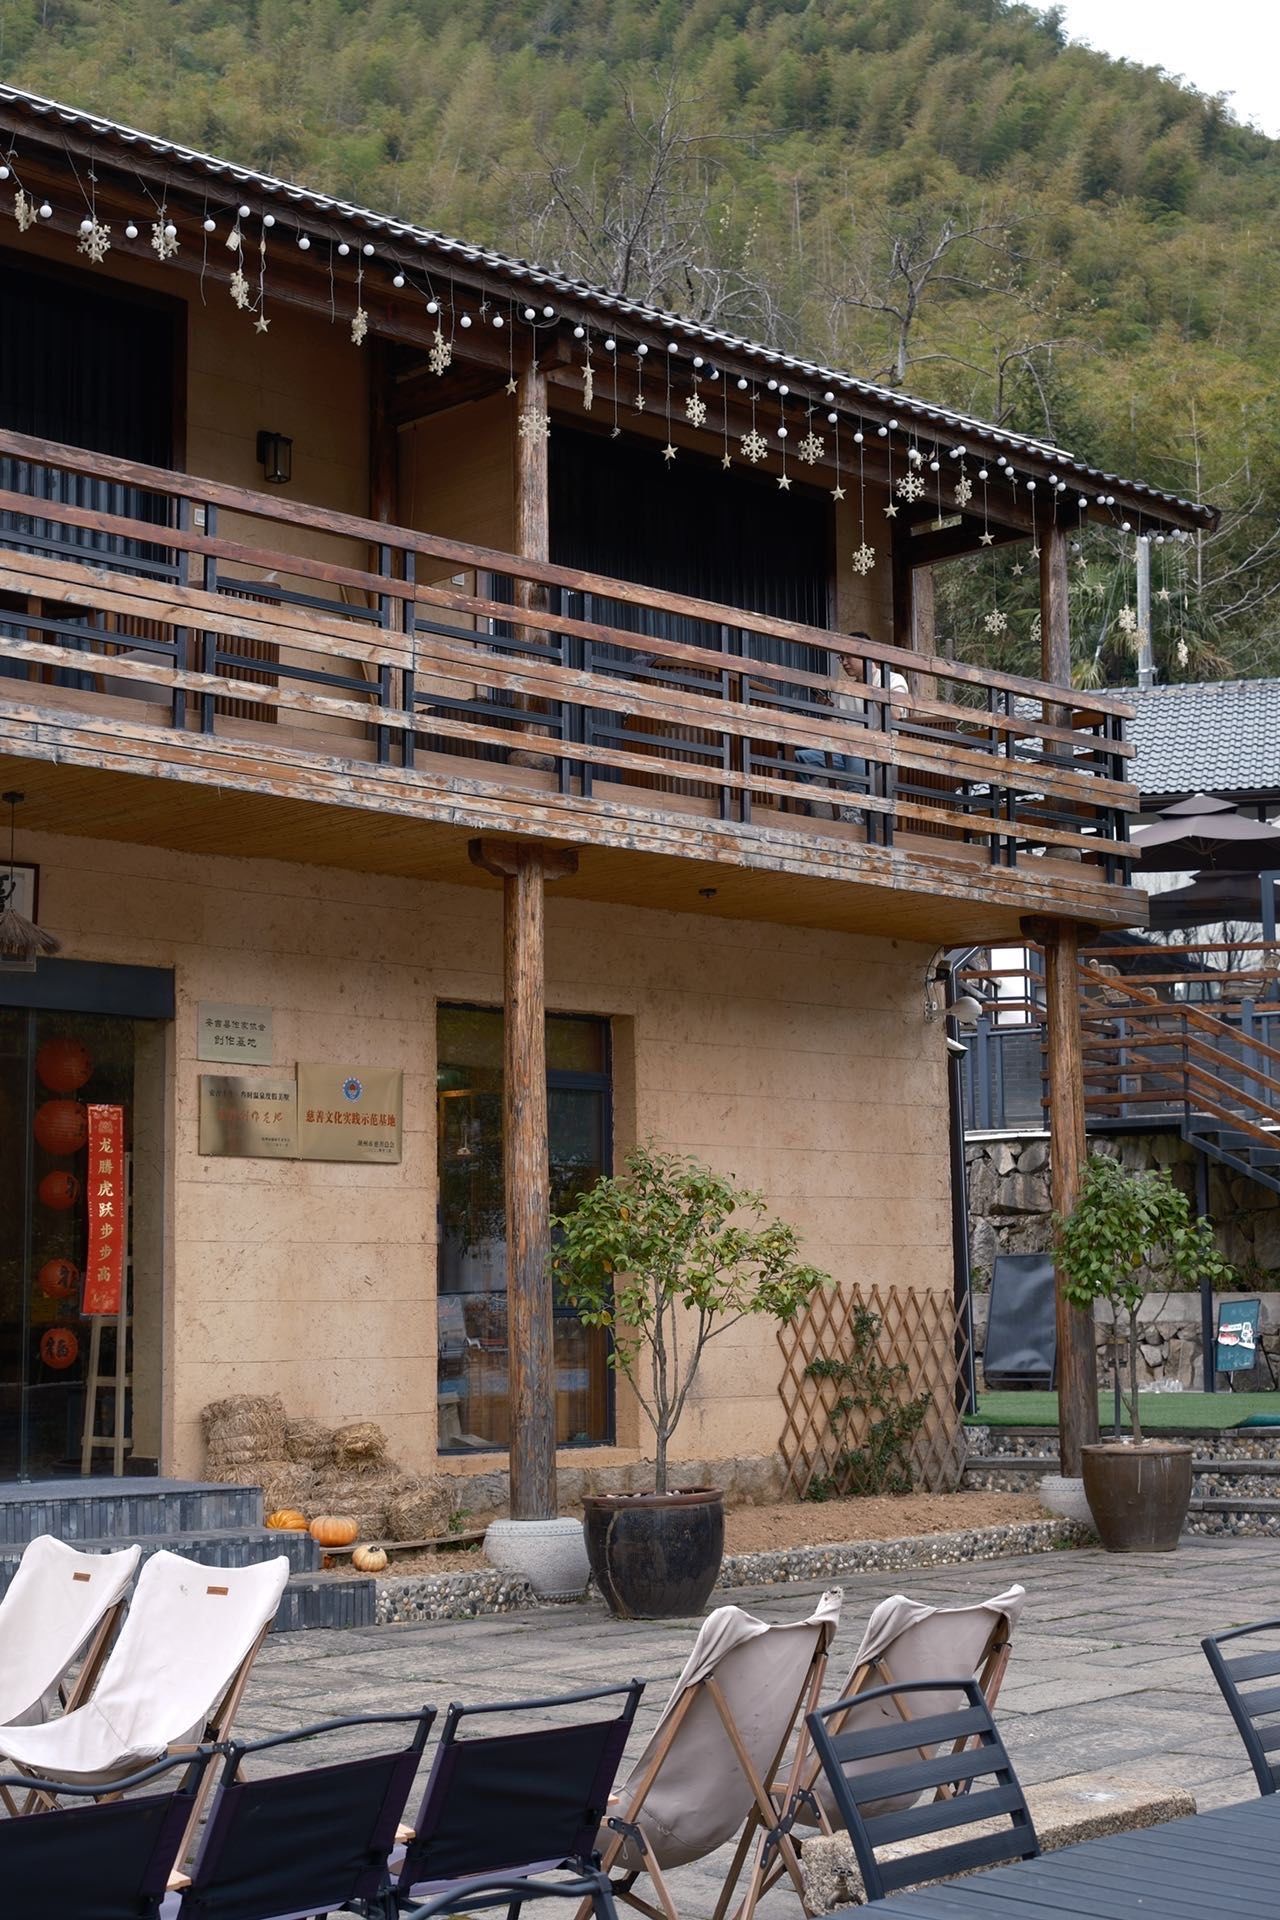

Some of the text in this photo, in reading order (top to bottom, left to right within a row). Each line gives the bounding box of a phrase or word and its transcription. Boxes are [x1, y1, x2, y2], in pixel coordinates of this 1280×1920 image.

[305, 1109, 396, 1127] 慈善文化实践示范基地
[97, 1137, 114, 1282] 龙腾虎跃步步高
